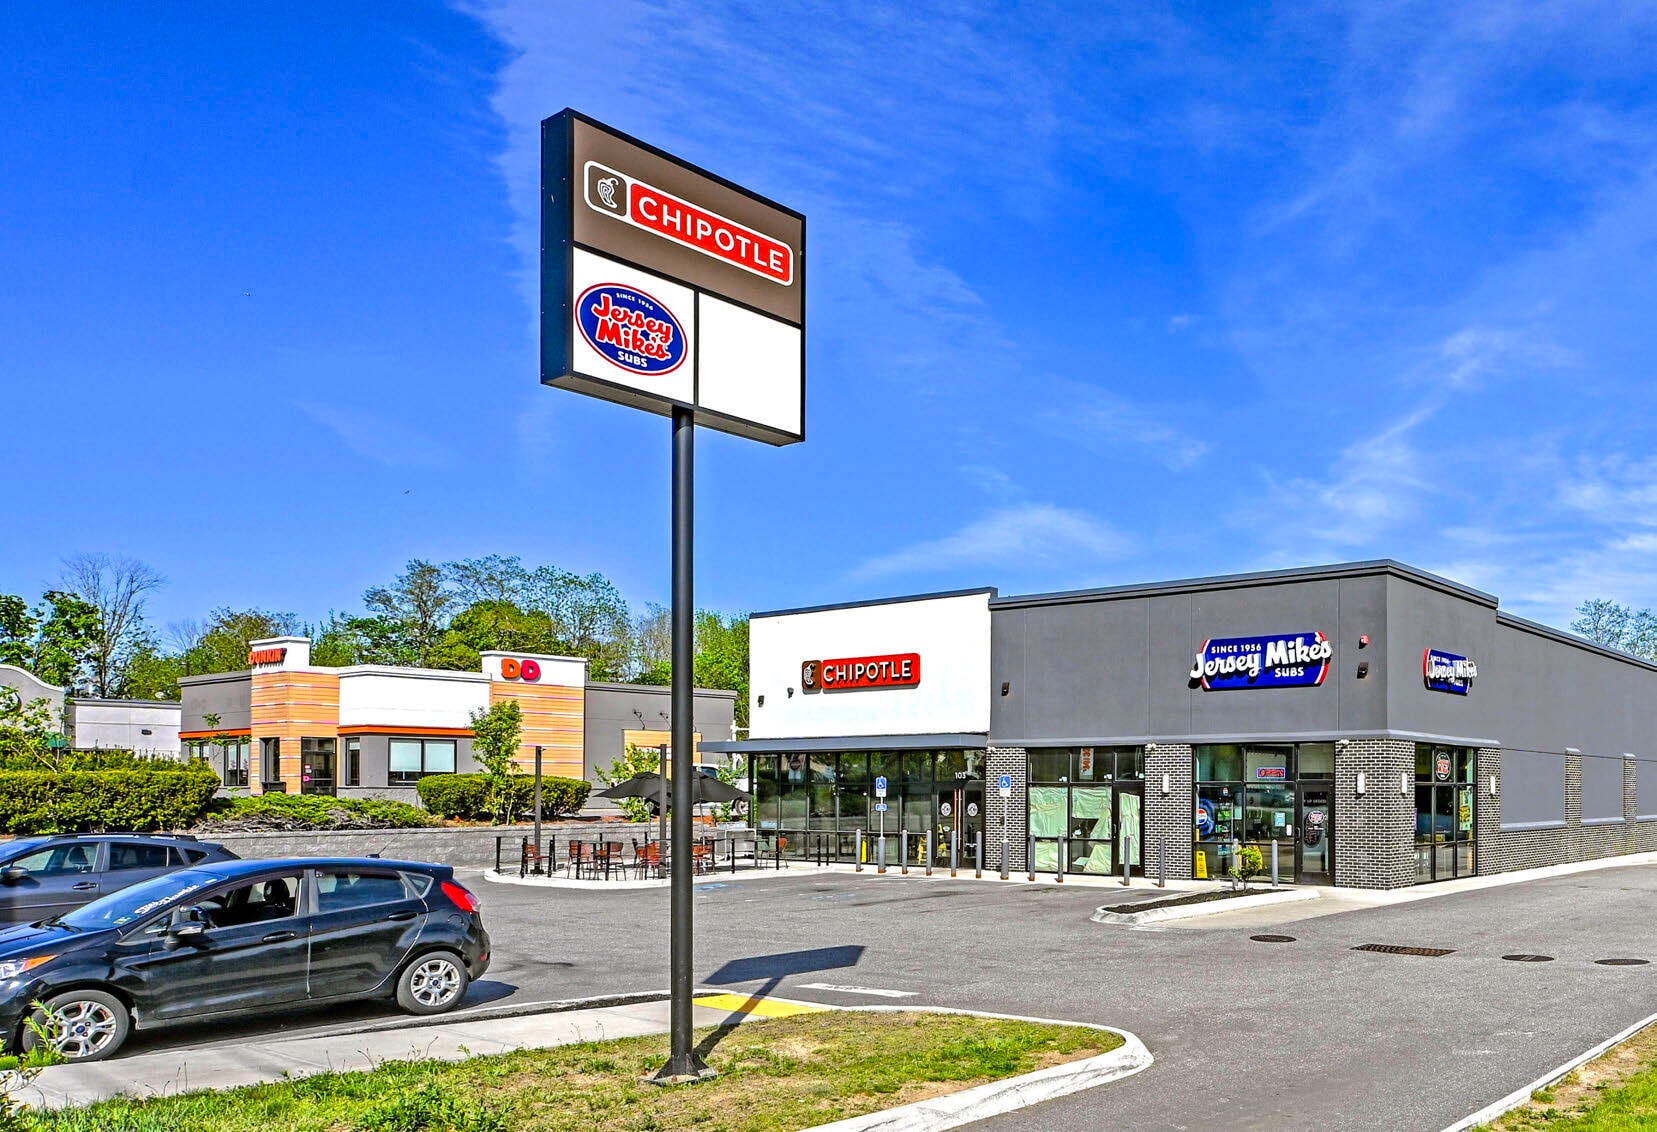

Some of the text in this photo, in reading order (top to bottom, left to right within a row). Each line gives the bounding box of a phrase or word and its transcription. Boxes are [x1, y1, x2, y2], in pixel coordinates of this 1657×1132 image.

[638, 196, 784, 274] CHIPOTLE
[616, 292, 636, 303] SINCE
[591, 293, 673, 345] Jersey
[596, 317, 671, 360] Mike's
[617, 350, 649, 368] SUBS
[1190, 632, 1332, 679] Jersey Mike's
[1211, 643, 1262, 654] SINCE 1956
[501, 658, 541, 680] DD
[823, 659, 913, 682] CHIPOTLE
[1274, 666, 1305, 678] SUBS
[954, 771, 967, 779] 103
